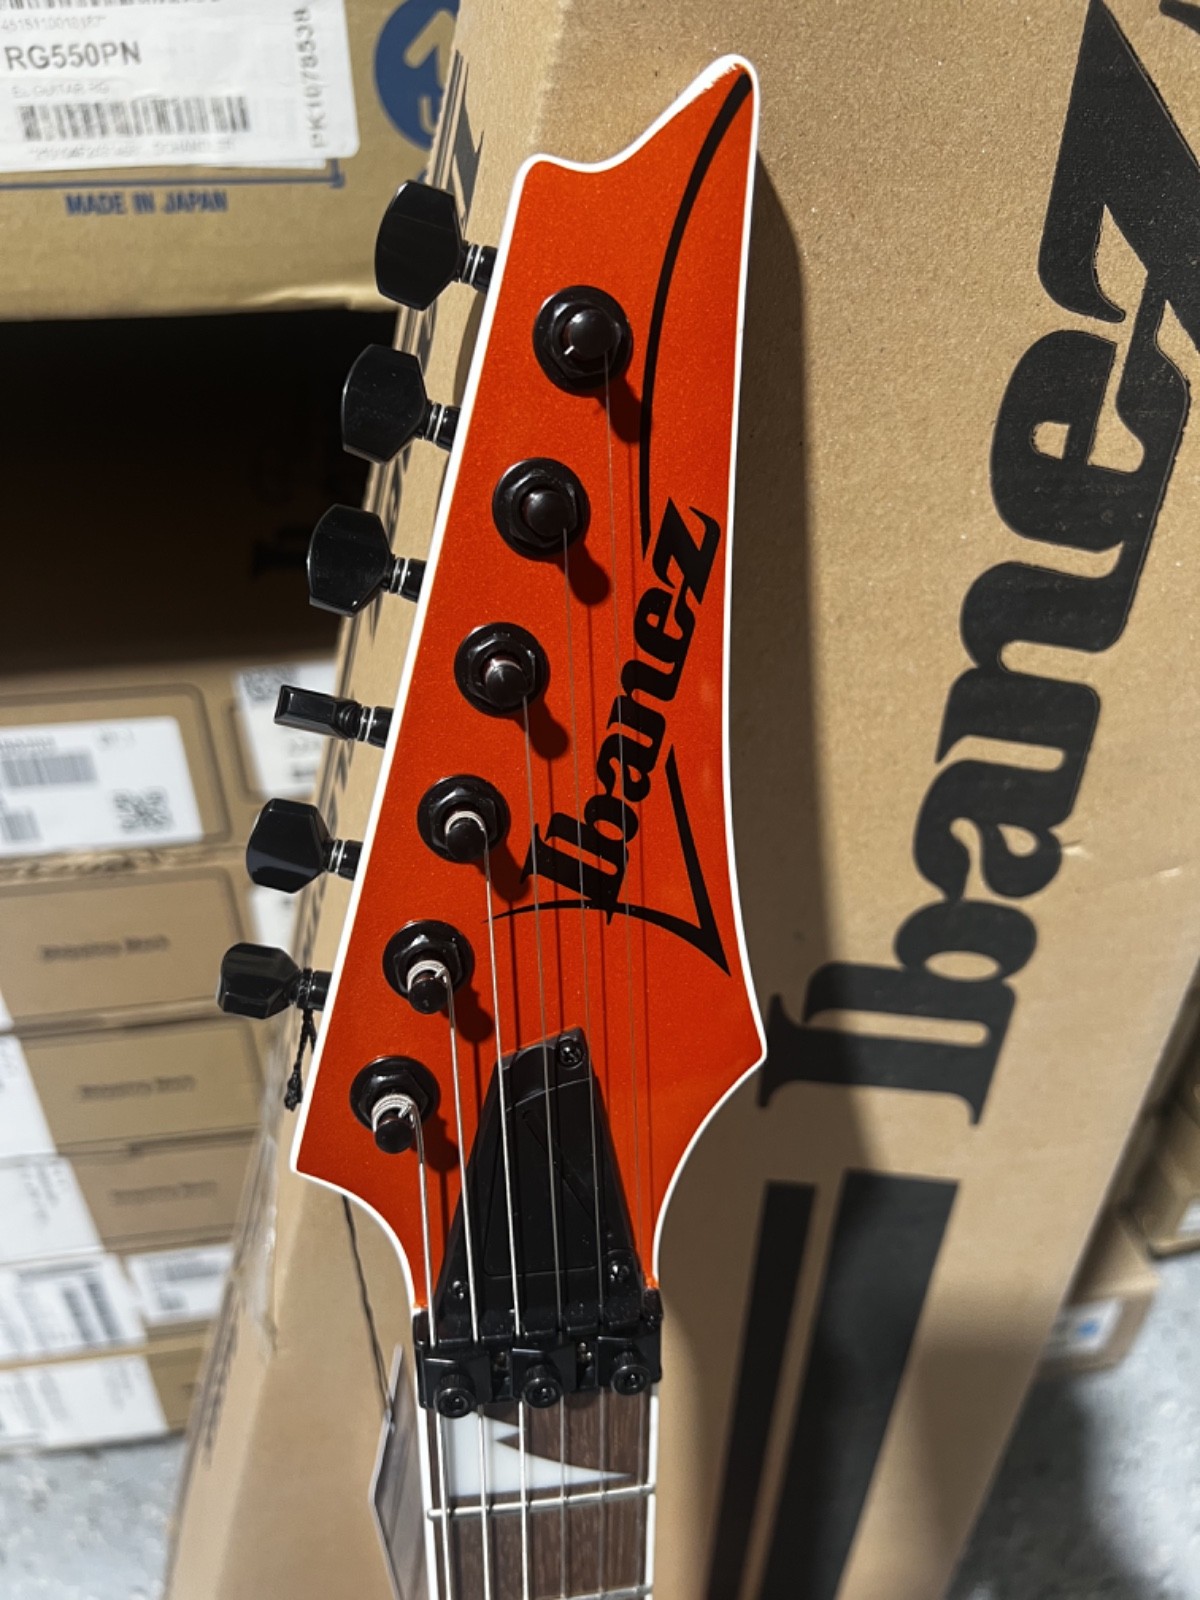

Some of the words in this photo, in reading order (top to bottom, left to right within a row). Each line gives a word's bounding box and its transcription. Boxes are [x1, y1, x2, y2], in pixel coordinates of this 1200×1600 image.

[4, 40, 142, 71] RG550PN
[65, 192, 126, 216] MADE
[132, 191, 156, 215] IN
[163, 189, 228, 215] JAPAN
[757, 0, 1200, 1127] Ibanez
[519, 496, 721, 926] Ibanez
